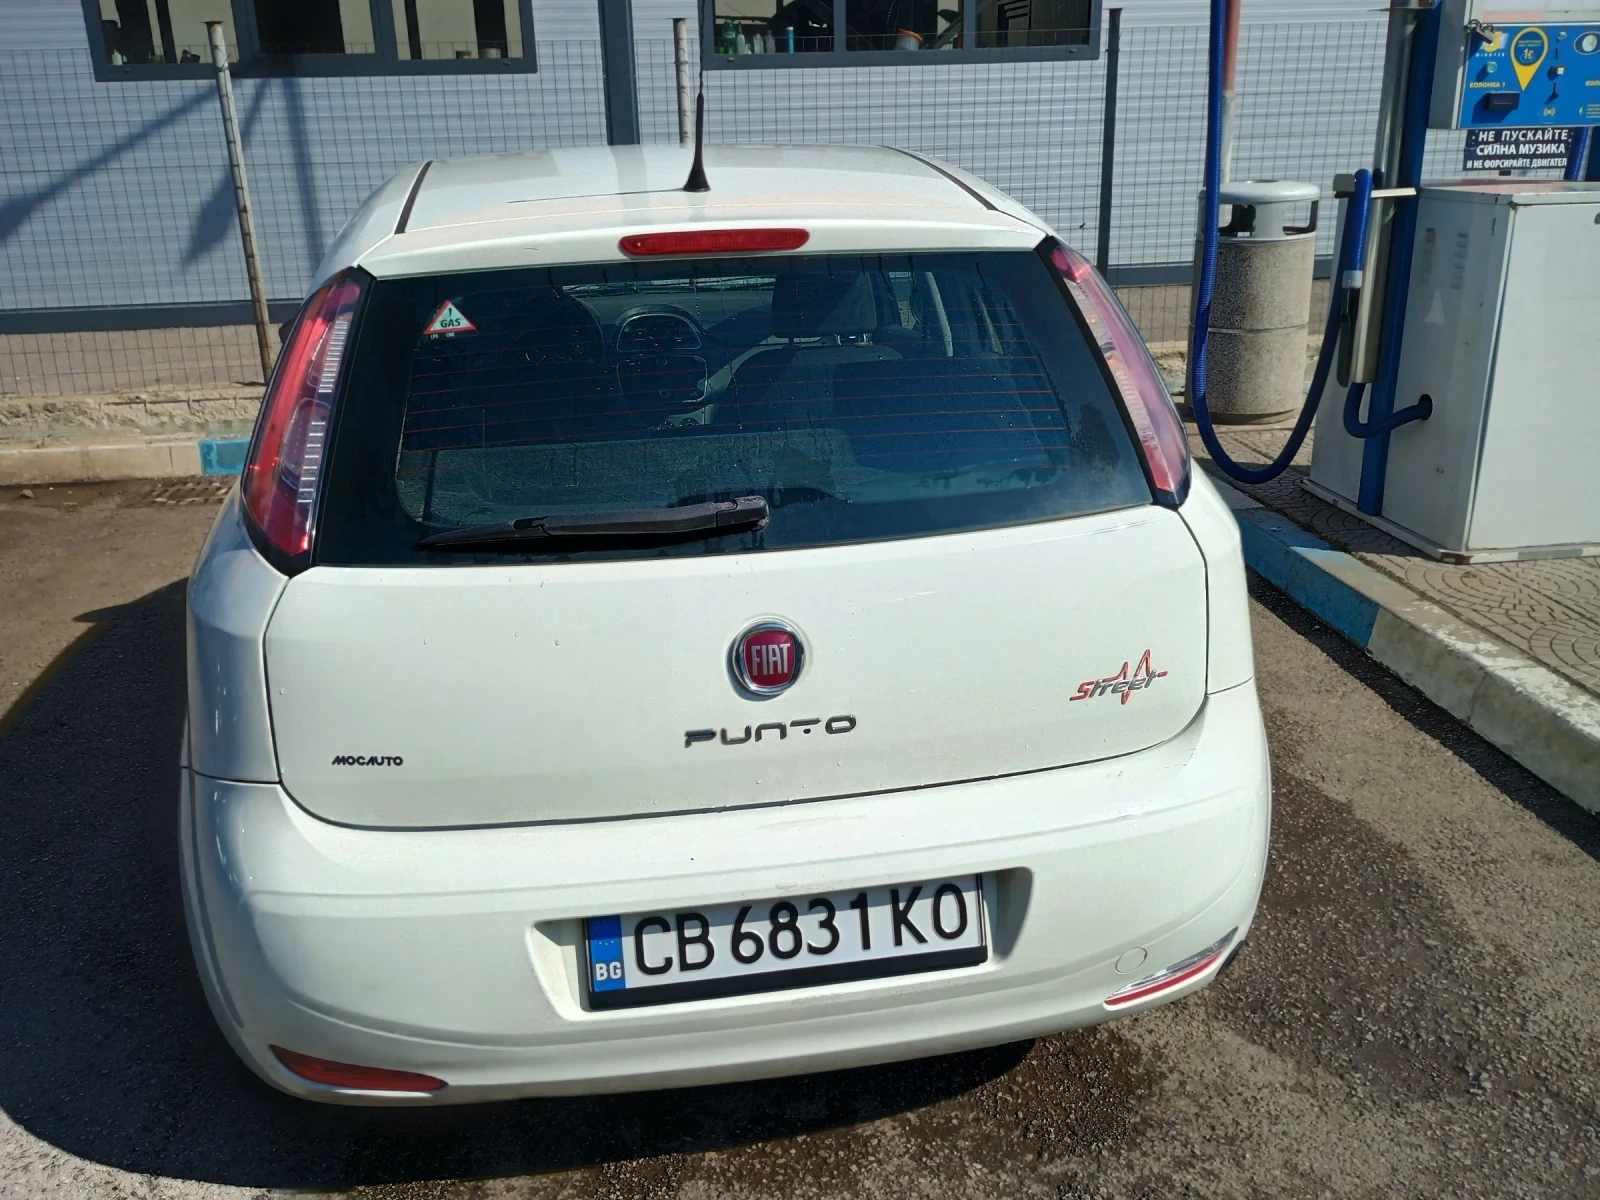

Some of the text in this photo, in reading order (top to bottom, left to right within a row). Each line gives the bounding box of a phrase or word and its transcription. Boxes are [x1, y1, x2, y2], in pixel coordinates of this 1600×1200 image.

[1469, 81, 1501, 89] КОЛОНКА
[1478, 128, 1569, 142] НЕ ПУСКАЙТЕ
[1476, 143, 1566, 156] СИЛНА МУЗИКА
[1466, 160, 1473, 169] И
[1473, 160, 1483, 169] НЕ
[1484, 158, 1531, 169] ФОРСИРАЙТЕ
[440, 318, 461, 328] GAS
[751, 643, 790, 676] FIAT
[1069, 660, 1160, 703] Street
[684, 714, 857, 748] PUNTO
[331, 755, 404, 767] MOCAUTO
[634, 883, 969, 976] CB 6831 KO
[595, 961, 622, 981] BG
